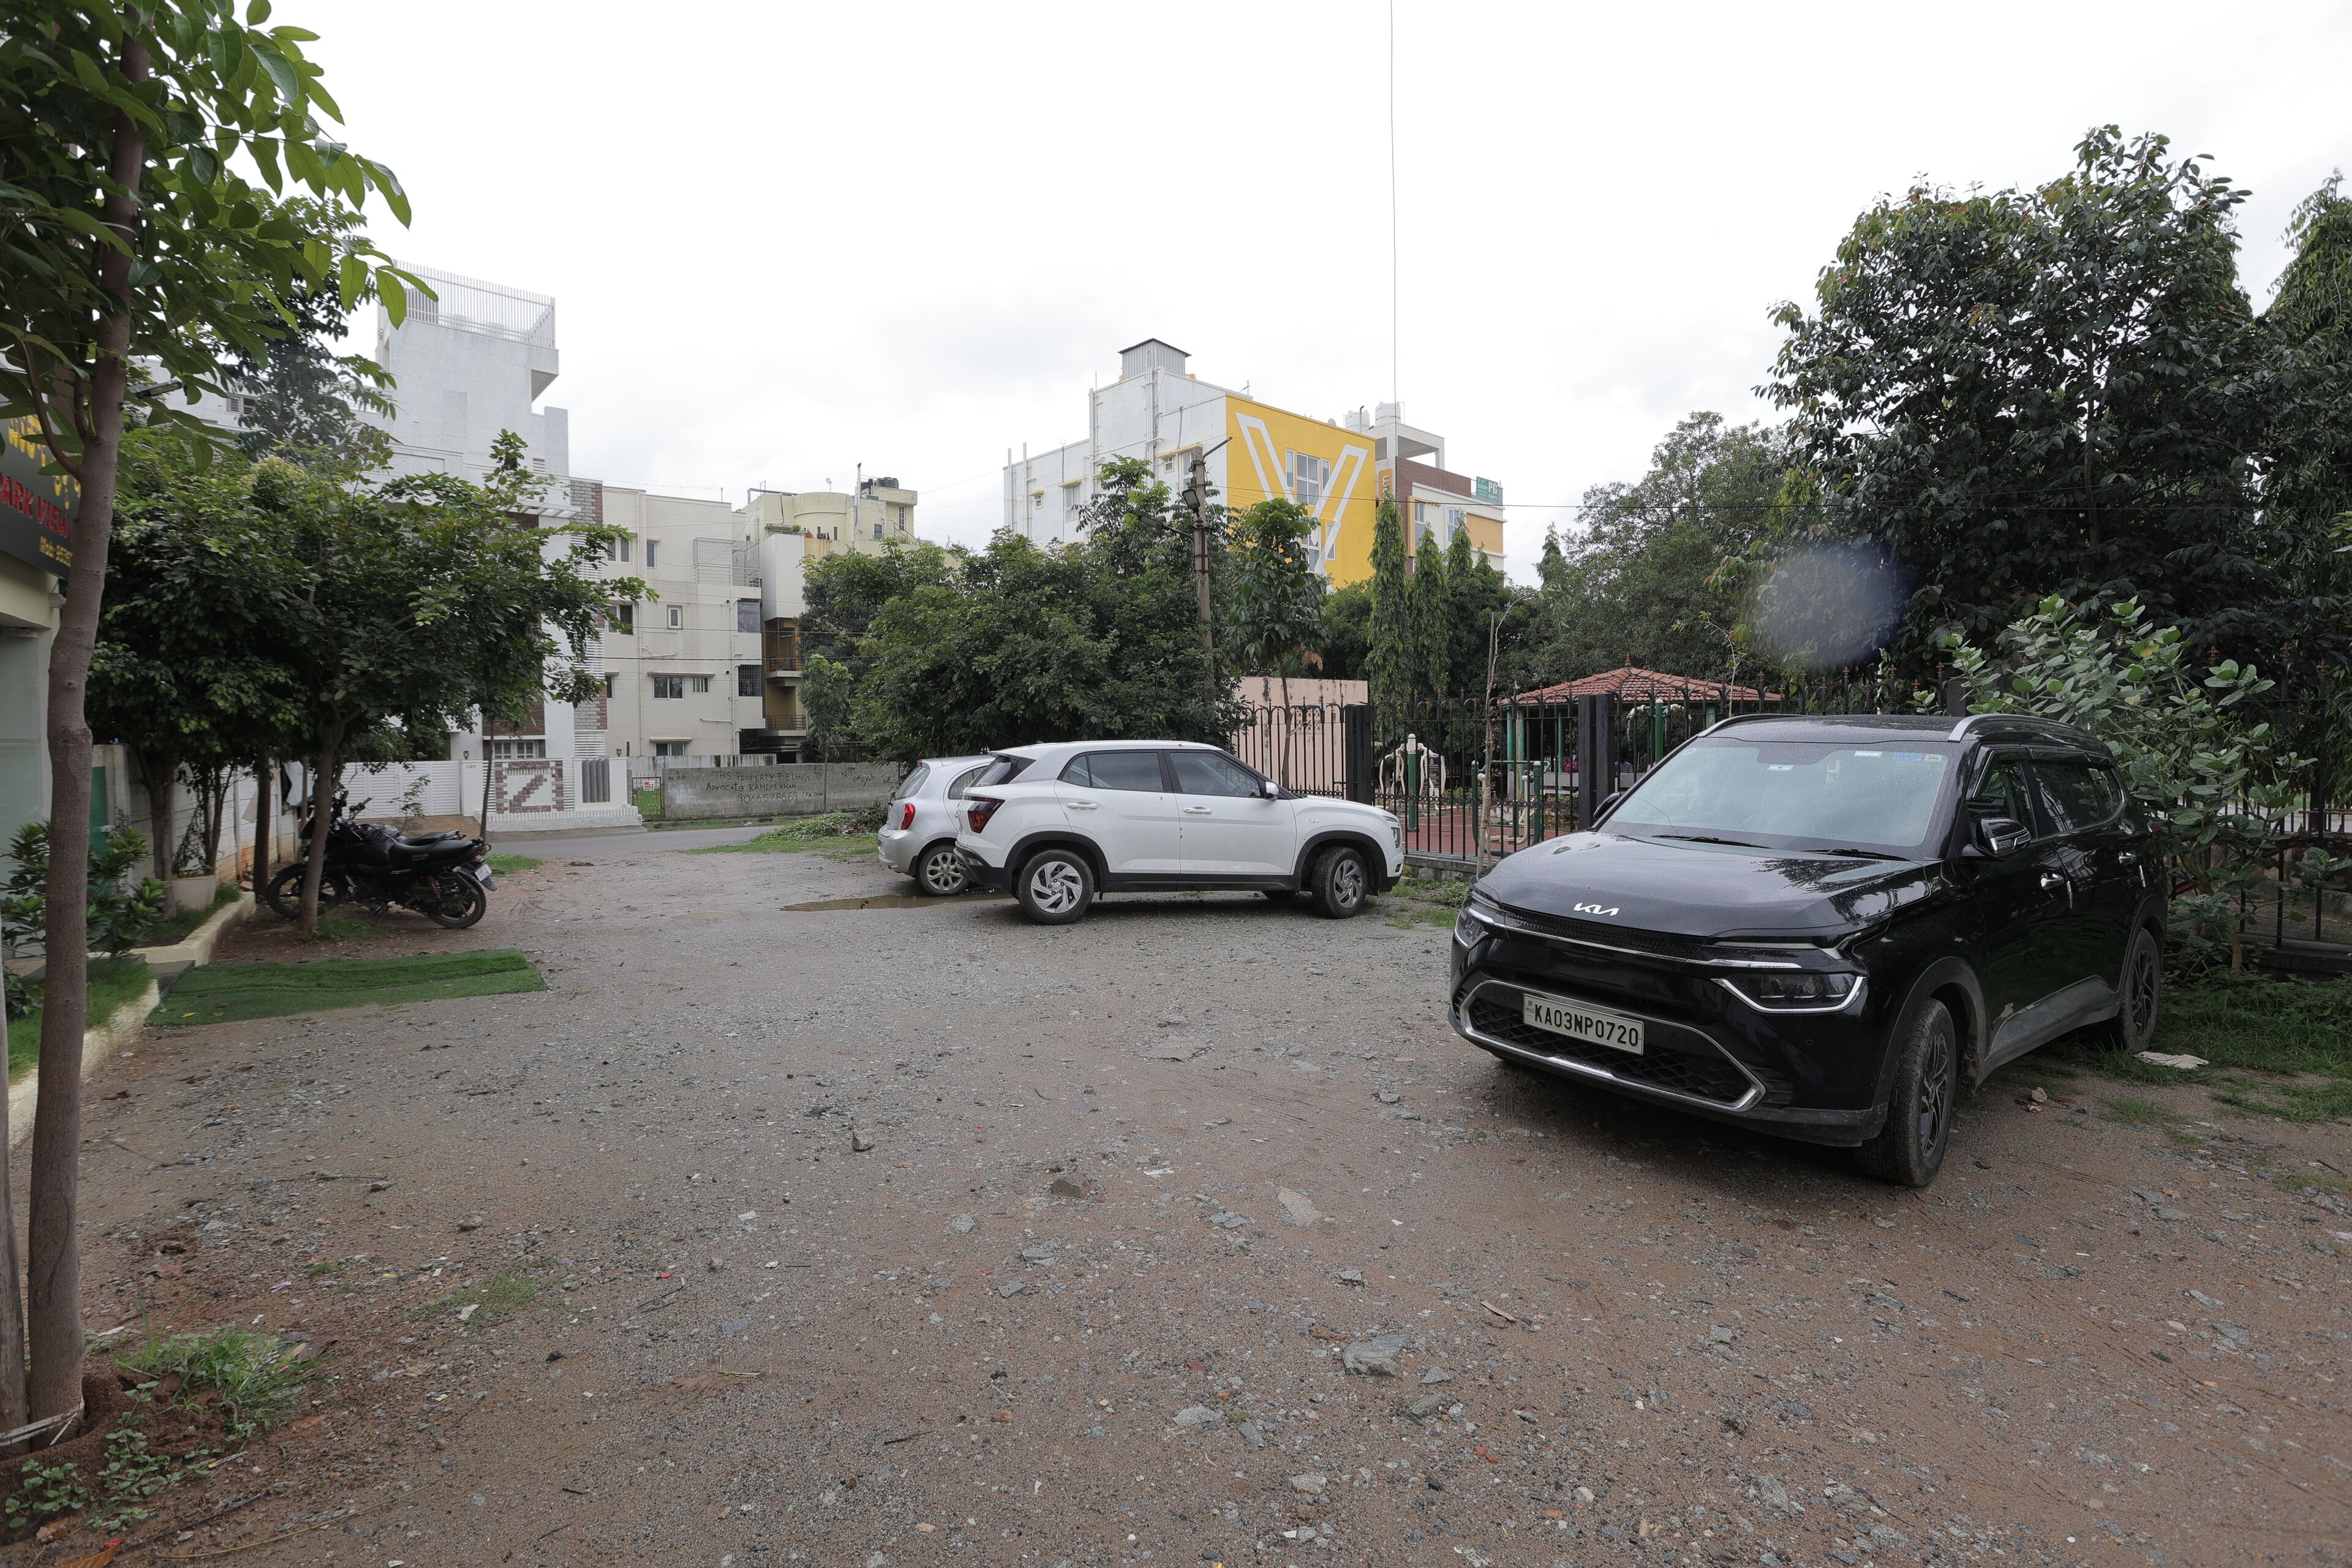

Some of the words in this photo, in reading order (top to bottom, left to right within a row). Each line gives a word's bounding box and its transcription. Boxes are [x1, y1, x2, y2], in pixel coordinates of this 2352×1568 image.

[1488, 481, 1498, 494] PG
[36, 496, 69, 538] VIEW
[841, 767, 856, 778] NOT
[861, 773, 874, 786] SALE
[1534, 1003, 1639, 1047] KA03NP0720
